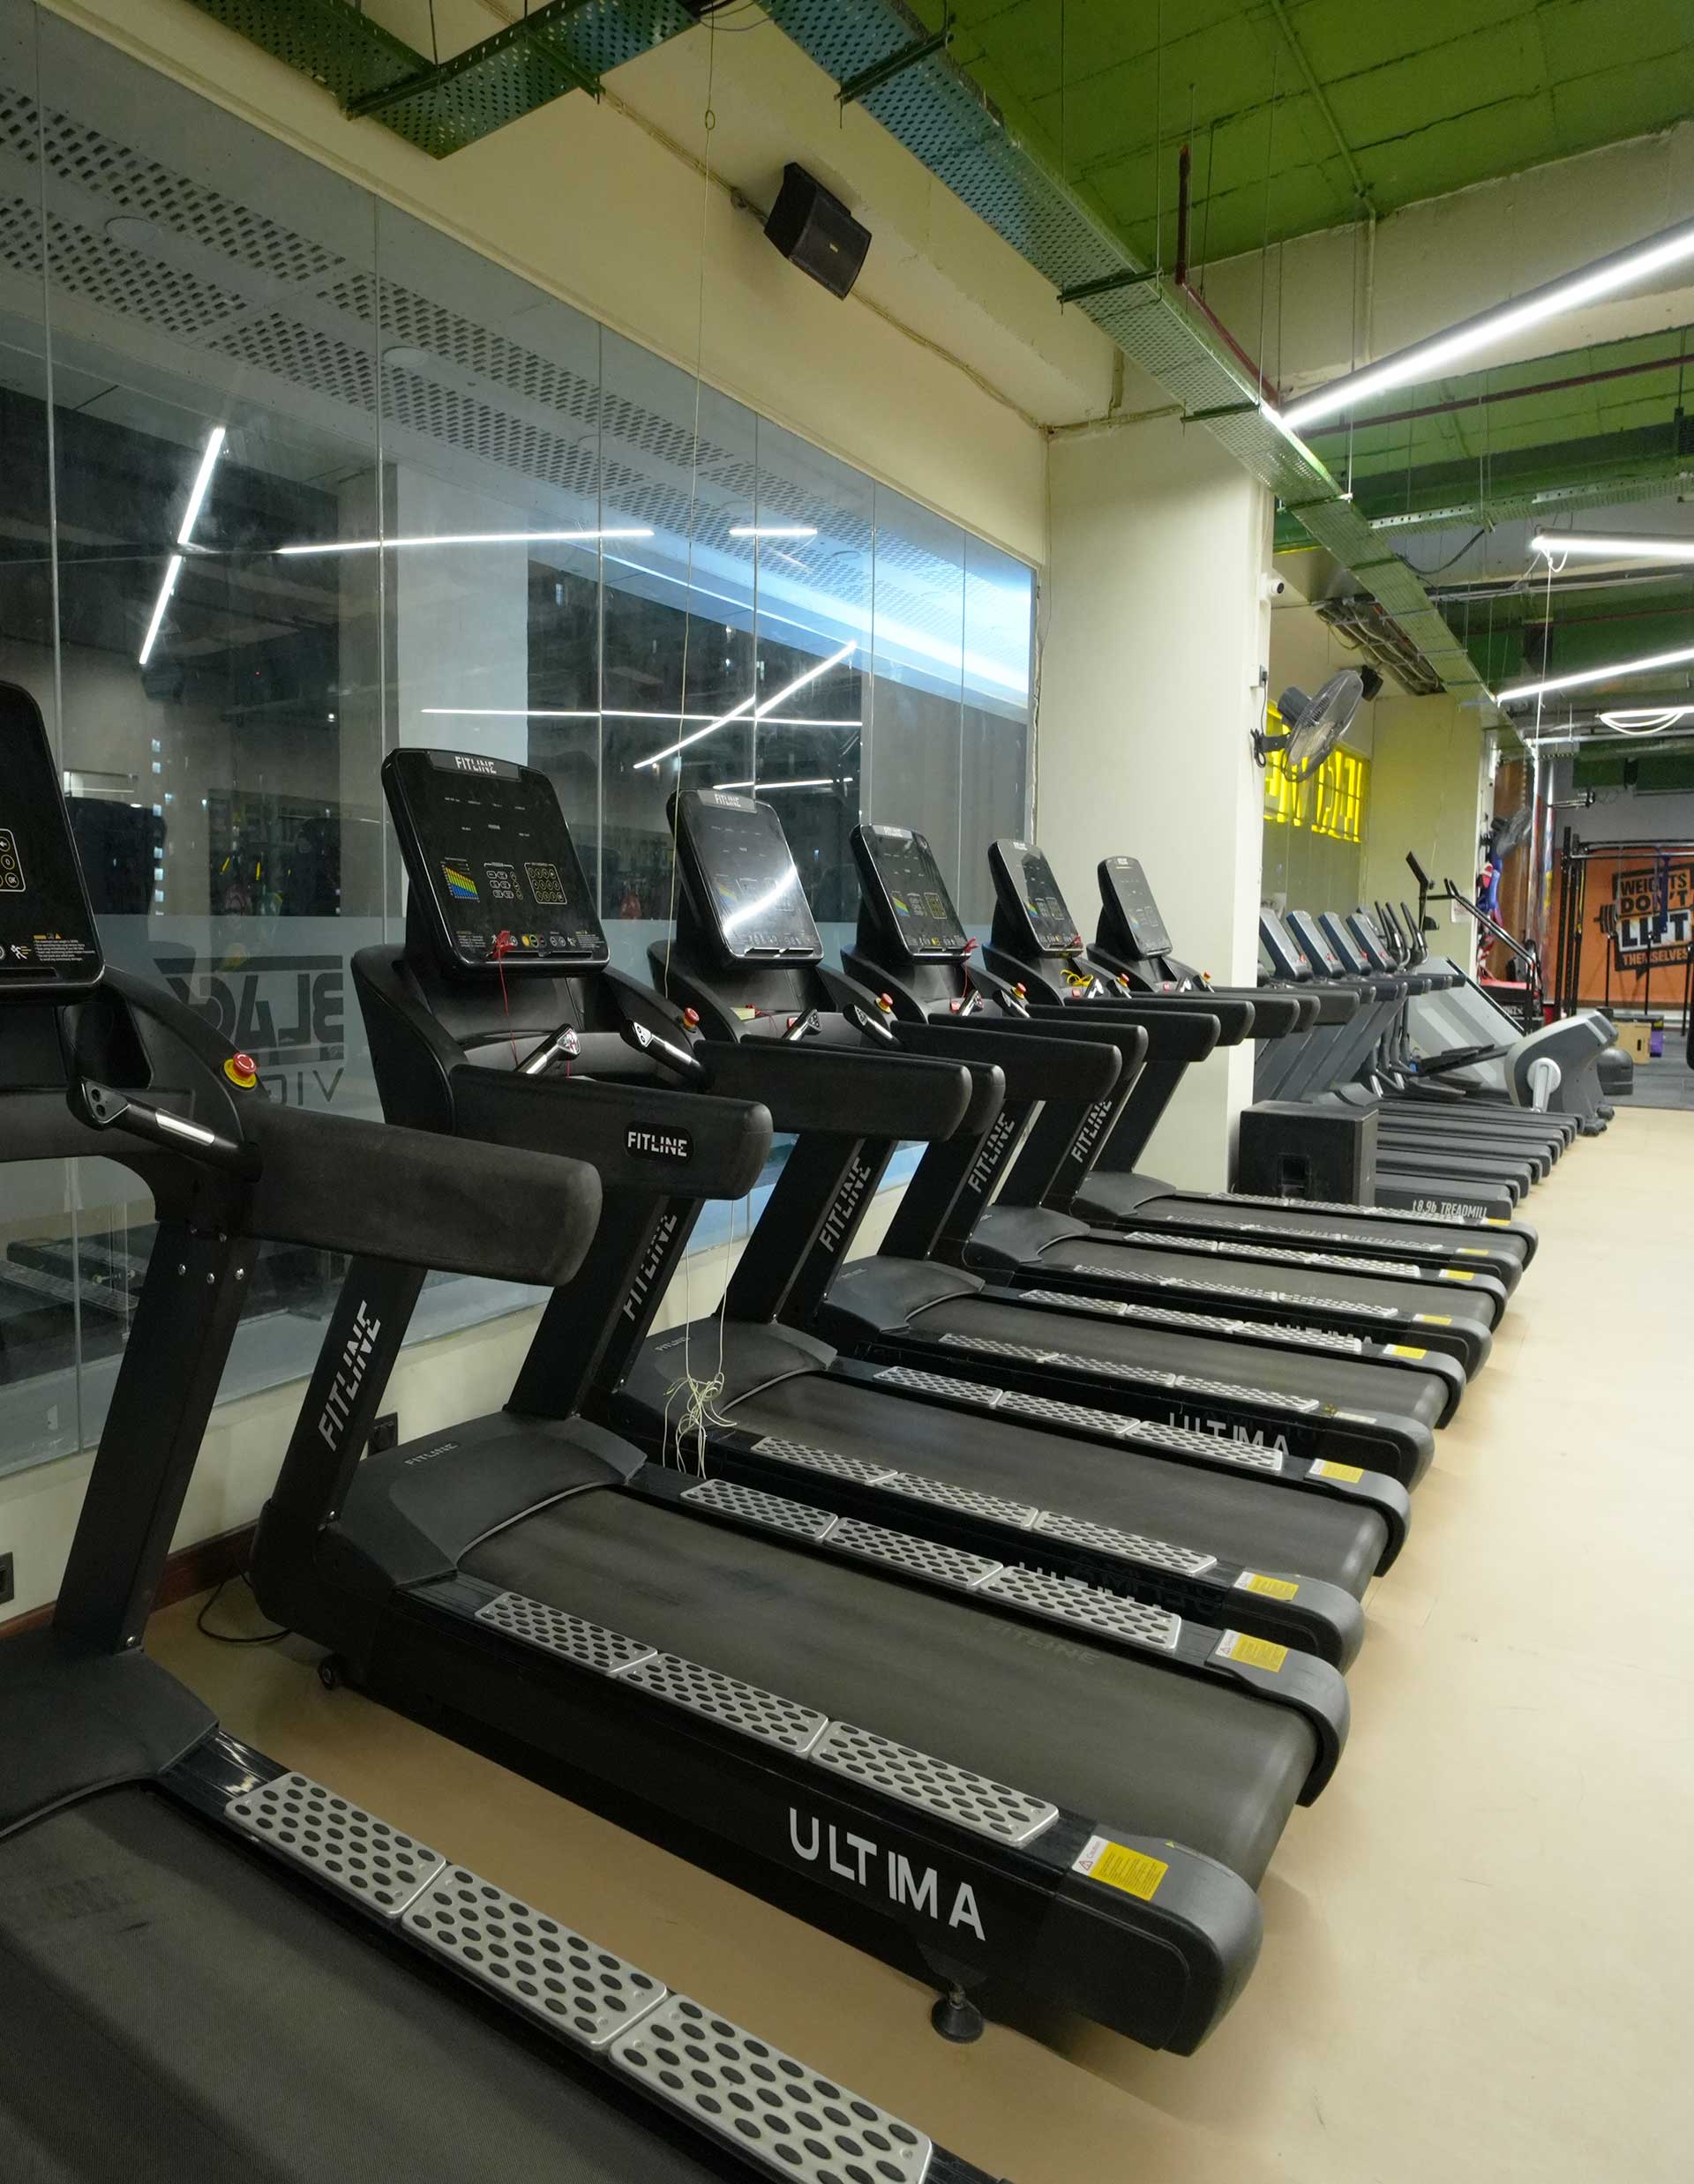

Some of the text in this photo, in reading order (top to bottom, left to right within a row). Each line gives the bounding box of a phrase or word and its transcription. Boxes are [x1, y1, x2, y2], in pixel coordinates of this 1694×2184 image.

[454, 756, 497, 774] FITLINE
[1621, 872, 1687, 895] WEIGTS
[627, 1131, 687, 1157] FITLINE
[968, 1112, 1016, 1193] FITLINE
[1071, 1100, 1113, 1163] FITLINE
[819, 1156, 871, 1253] FITLINE
[1440, 1201, 1488, 1218] TREADMILL
[318, 1299, 381, 1452] FITLINE
[404, 1443, 458, 1464] FITLINE
[790, 1806, 986, 1941] ULTIMA
